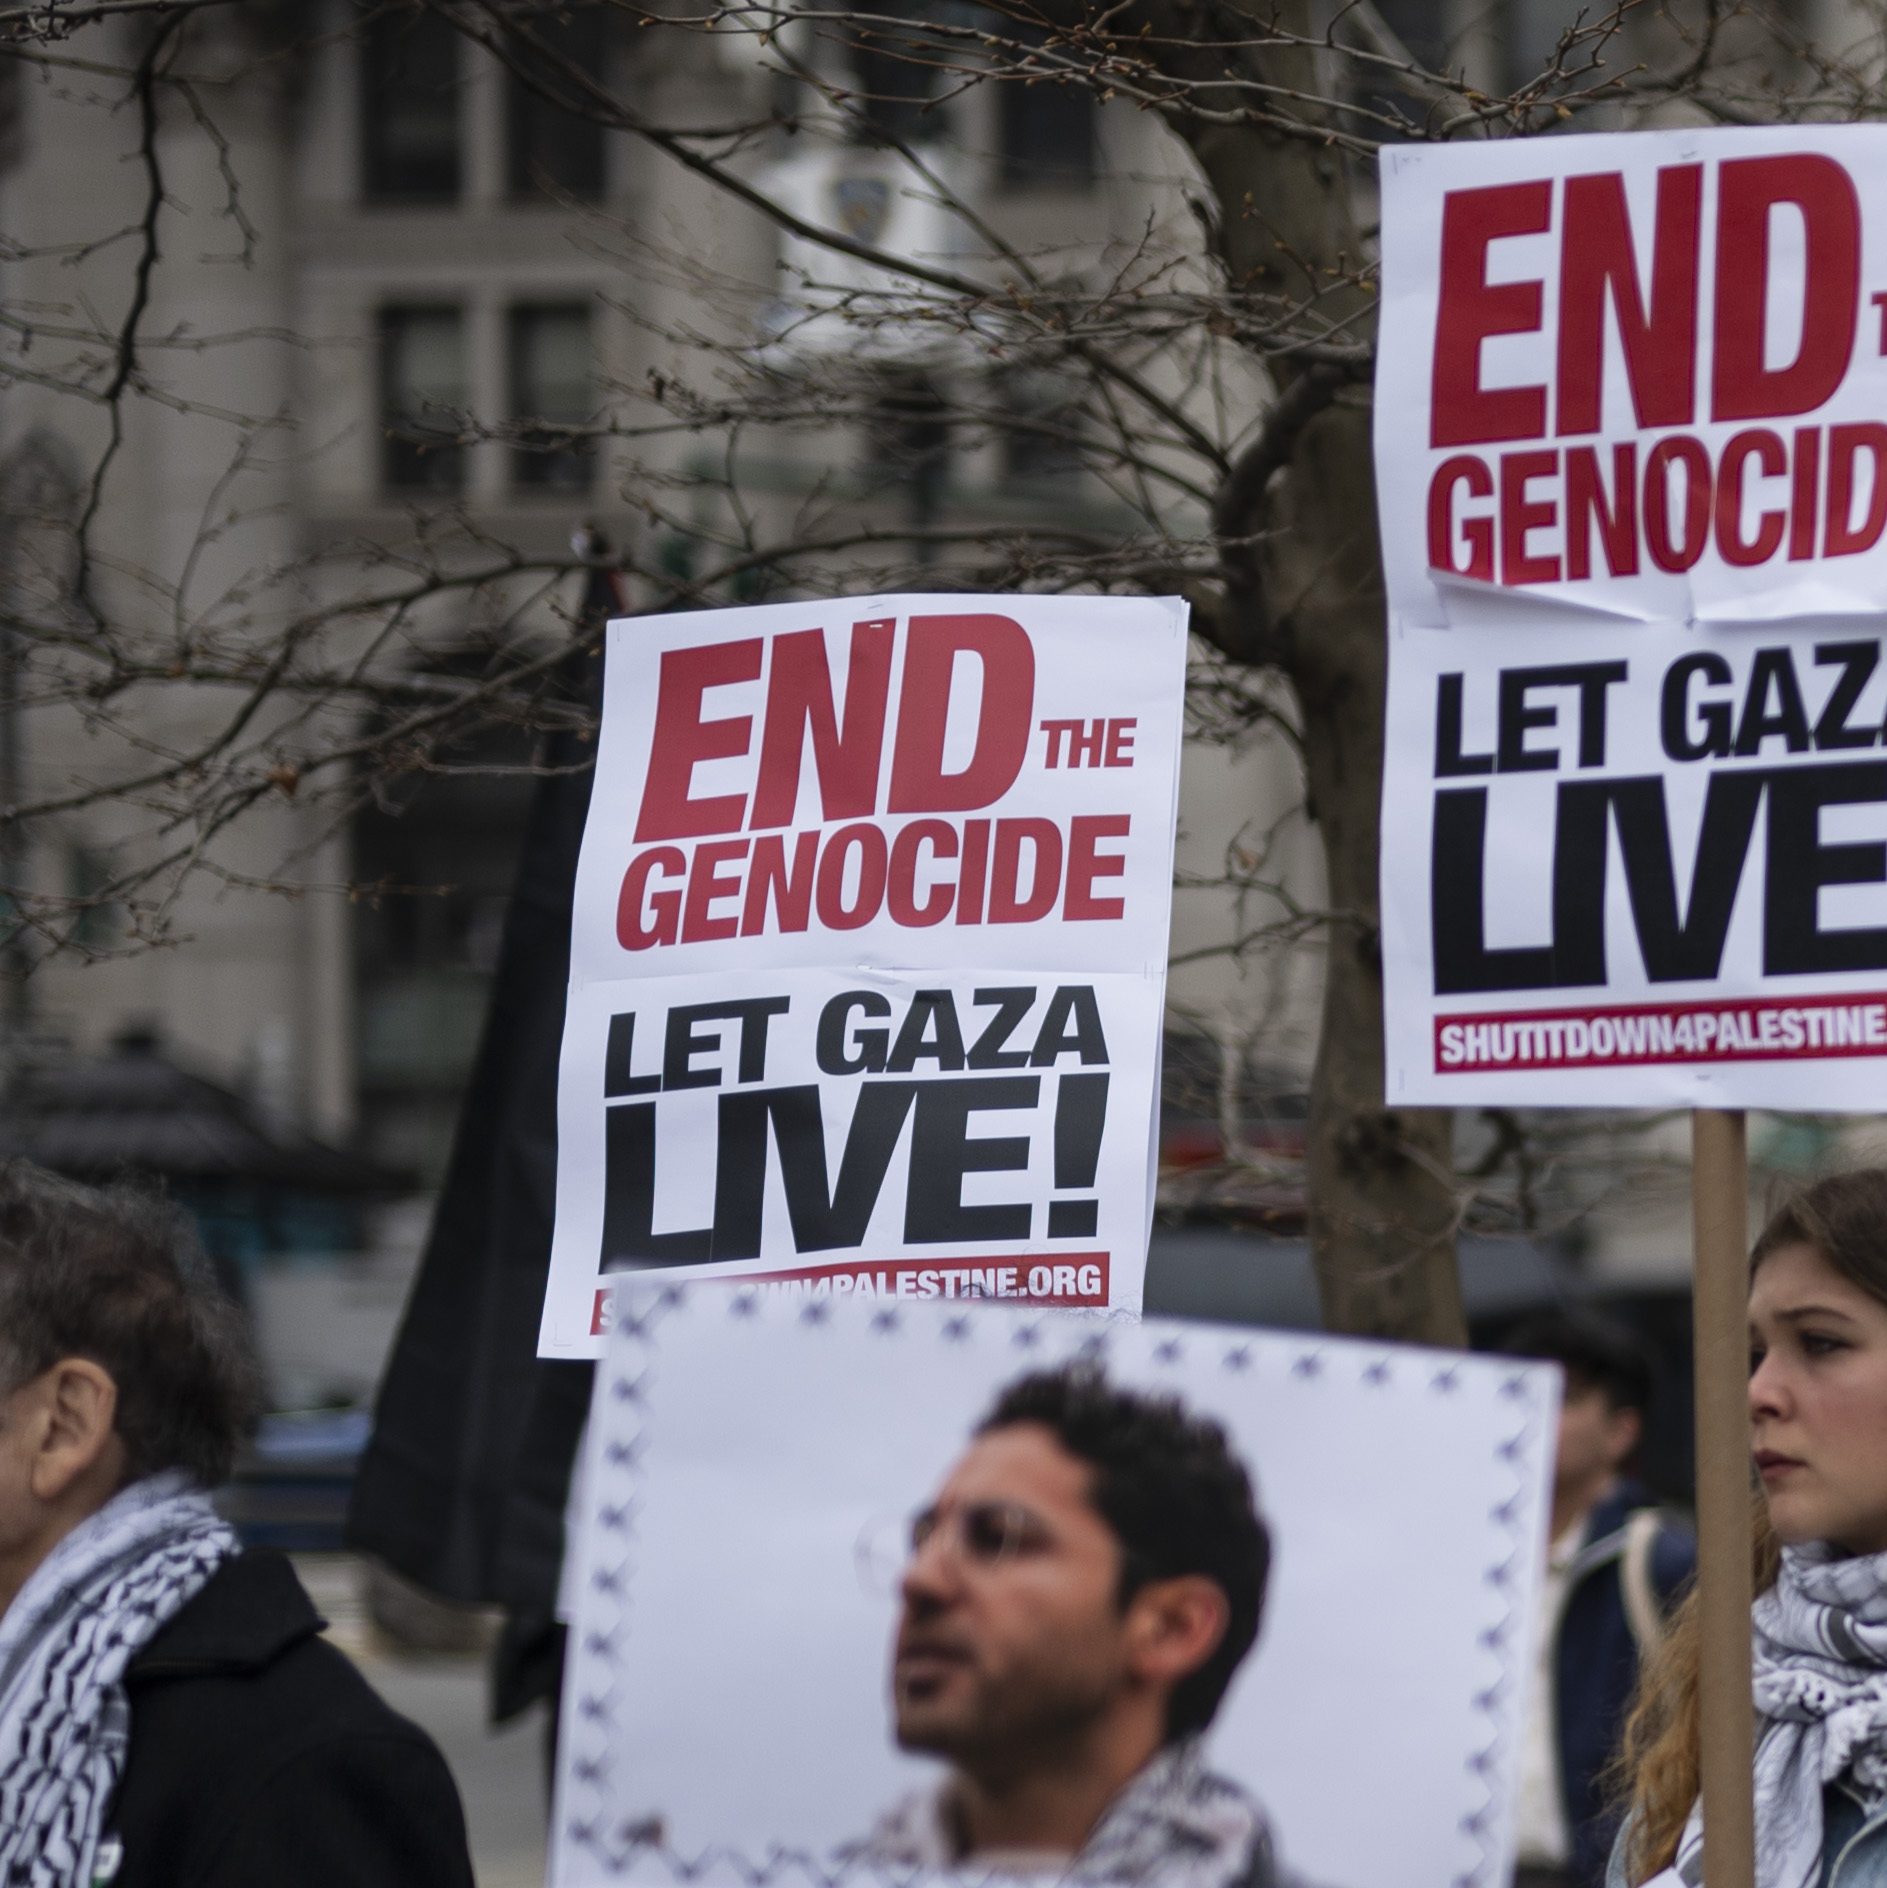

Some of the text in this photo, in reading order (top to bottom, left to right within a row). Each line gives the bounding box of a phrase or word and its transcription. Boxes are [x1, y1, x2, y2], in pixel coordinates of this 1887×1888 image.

[1430, 151, 1861, 449] END
[634, 612, 1136, 843] END THE
[1435, 659, 1629, 779] LET
[617, 814, 1130, 952] GENOCIDE
[604, 984, 1109, 1097] LET GAZA
[600, 1072, 1109, 1275] LIVE!
